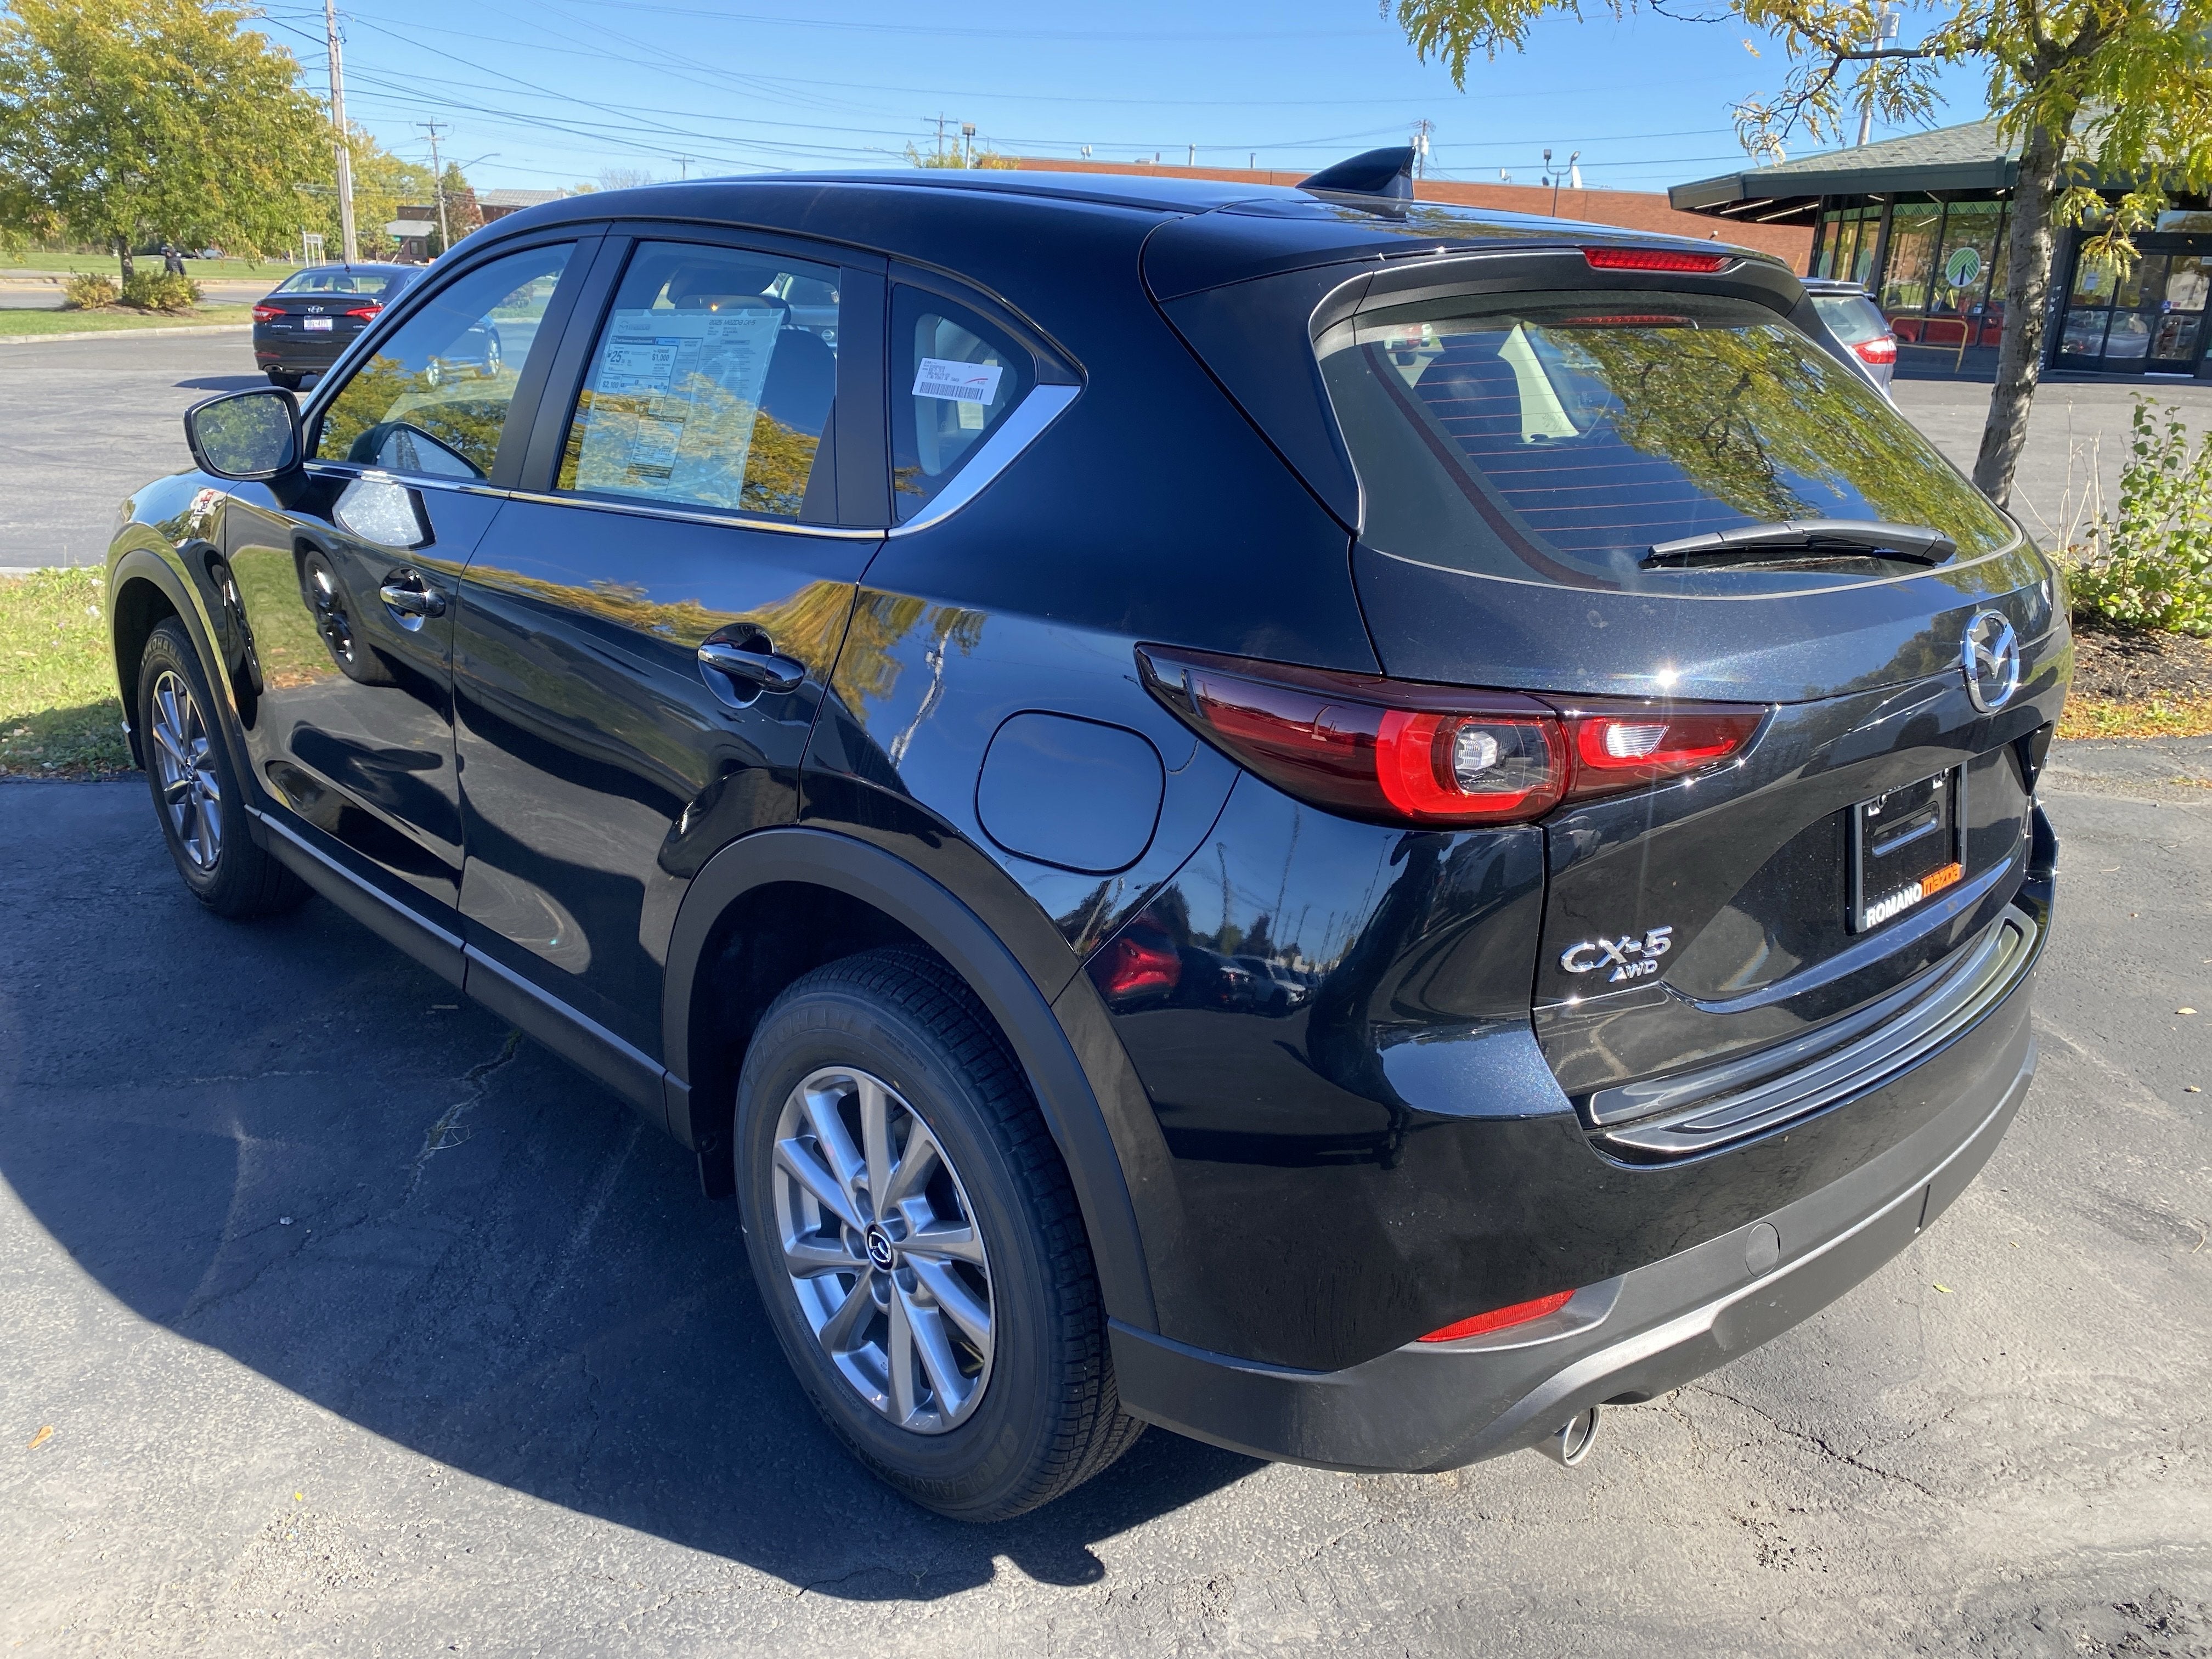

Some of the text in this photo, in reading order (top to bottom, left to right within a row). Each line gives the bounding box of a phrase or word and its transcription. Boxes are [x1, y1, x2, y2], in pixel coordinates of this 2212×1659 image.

[610, 351, 623, 363] 25
[652, 353, 670, 362] $1,000
[1865, 882, 1923, 928] ROMANO
[1560, 925, 1673, 973] CX-5
[1607, 958, 1658, 983] AWD
